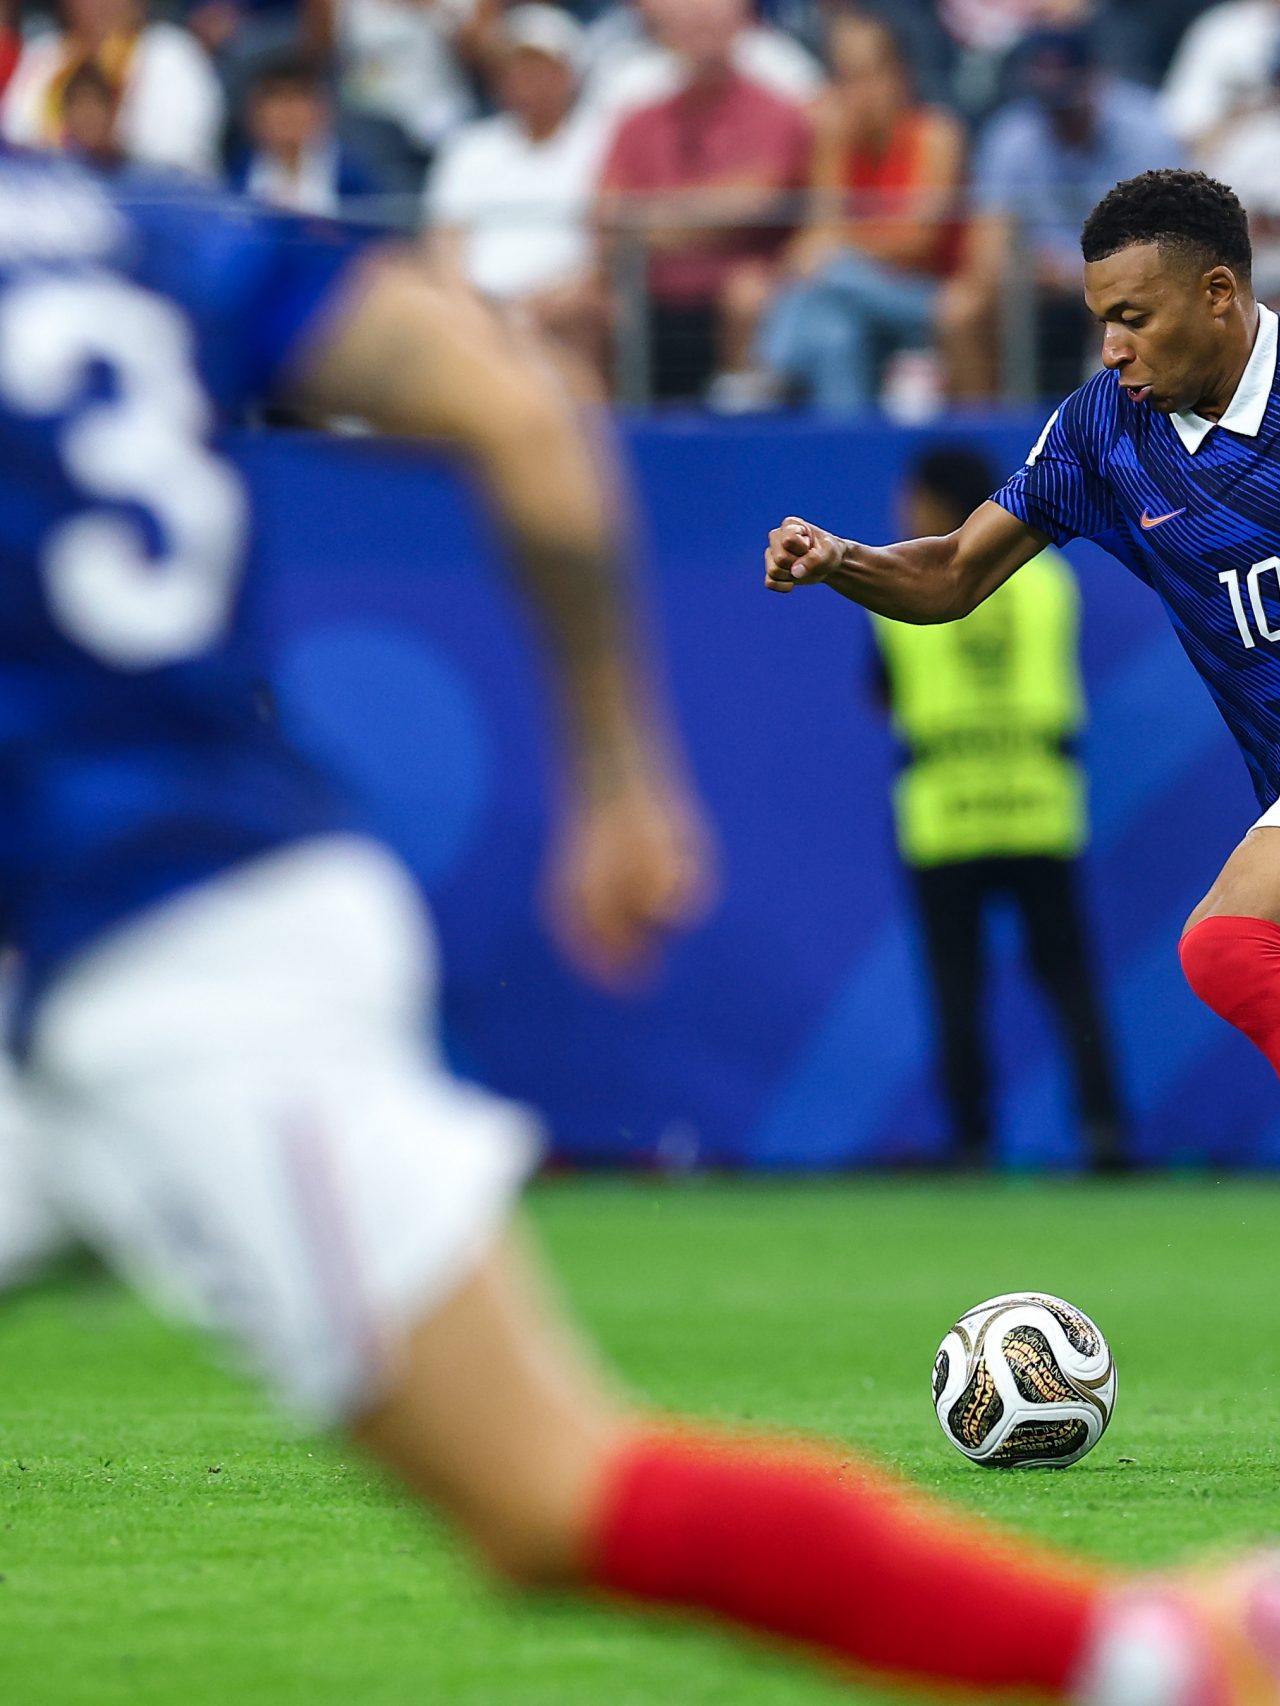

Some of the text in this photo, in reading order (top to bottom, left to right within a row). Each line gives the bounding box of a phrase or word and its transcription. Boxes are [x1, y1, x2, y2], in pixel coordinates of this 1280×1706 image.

[0, 266, 250, 672] 3
[1002, 1348, 1031, 1368] NEW
[1025, 1365, 1066, 1402] JERSEY
[1006, 1340, 1041, 1364] NEW
[962, 1371, 985, 1441] DALLAS
[970, 1373, 994, 1445] MIAMI
